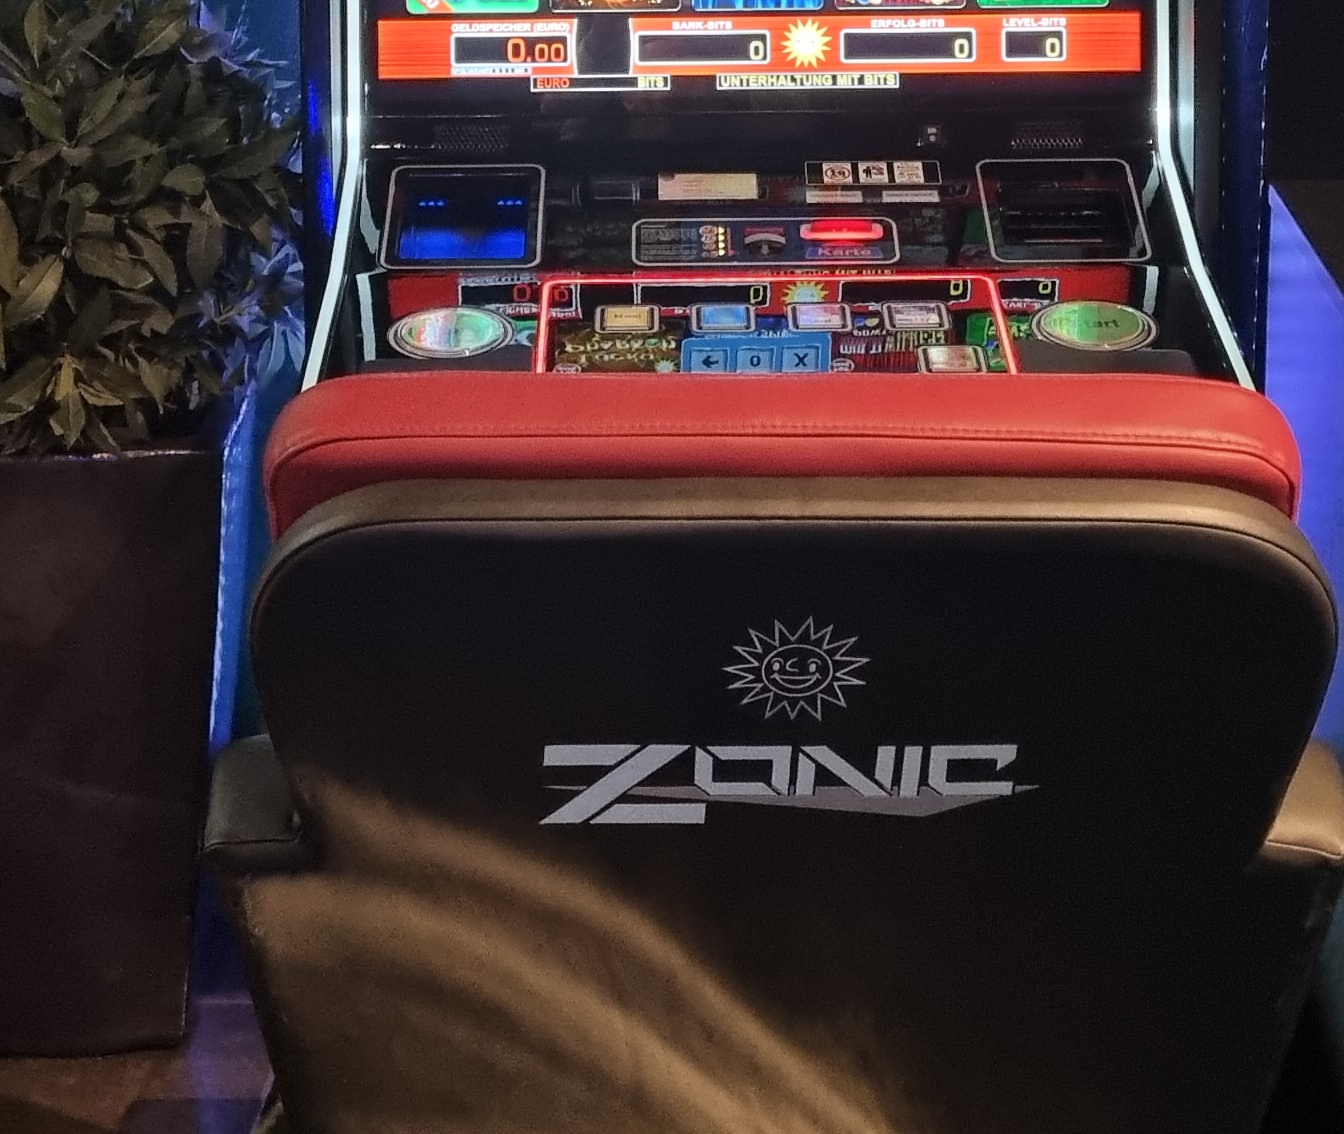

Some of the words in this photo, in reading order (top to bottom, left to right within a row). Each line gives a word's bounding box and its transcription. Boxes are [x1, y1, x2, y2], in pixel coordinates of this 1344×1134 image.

[451, 23, 531, 33] GELDSPEICHER
[533, 23, 570, 33] (EURO)
[672, 21, 732, 30] BANK-BITS
[871, 19, 945, 28] ERFOLG-BITS
[1003, 17, 1067, 27] LEVEL-BITS
[507, 38, 565, 63] 0.00
[749, 40, 764, 61] 0
[954, 38, 970, 58] 0
[1045, 37, 1060, 58] 0
[536, 78, 570, 89] EURO
[638, 76, 665, 89] BITS
[720, 74, 833, 87] UNTERHALTUNG
[836, 74, 862, 86] MIT
[865, 73, 896, 86] BITS
[818, 248, 871, 256] Karte
[539, 744, 1018, 824] ZONIC
